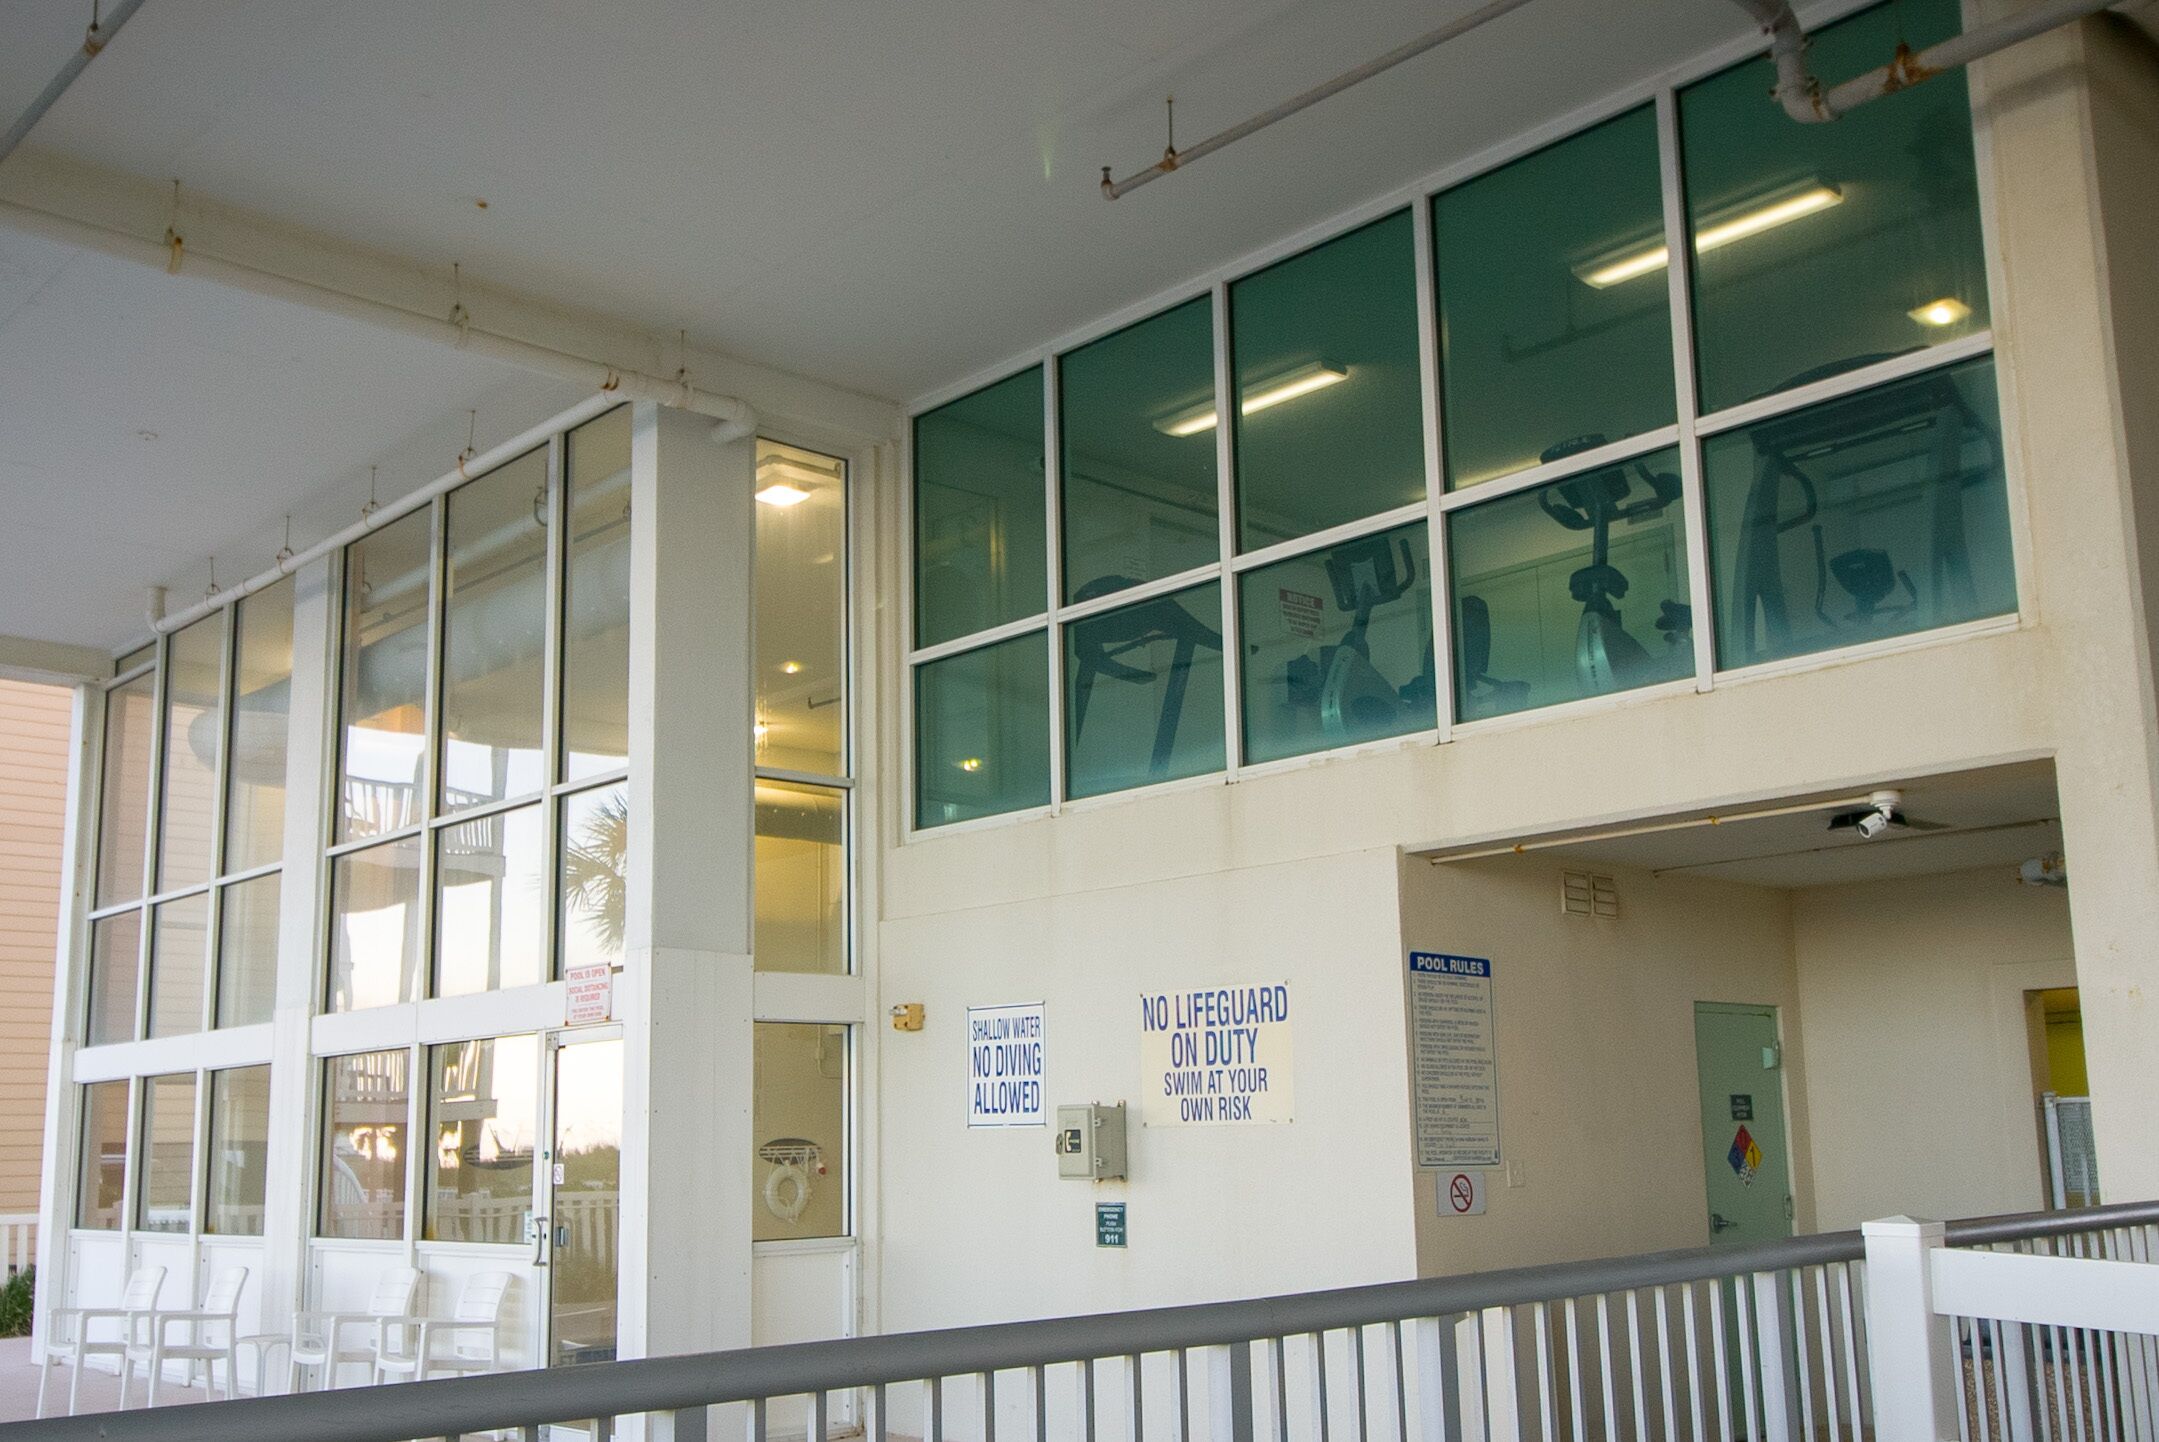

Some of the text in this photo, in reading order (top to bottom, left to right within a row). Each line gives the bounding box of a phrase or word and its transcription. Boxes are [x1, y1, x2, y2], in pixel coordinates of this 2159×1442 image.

[570, 967, 606, 981] POOL IS OPEN
[1417, 956, 1484, 975] POOL RULES
[1142, 985, 1288, 1032] NO LIFEGUARD
[972, 1016, 1041, 1041] SHALLOW WATER
[973, 1042, 1041, 1078] NO DIVING
[1171, 1027, 1258, 1068] ON DUTY
[1164, 1067, 1268, 1096] SWIM AT YOUR
[974, 1081, 1040, 1114] ALLOWED
[1180, 1095, 1252, 1122] OWN RISK
[1104, 1233, 1119, 1244] 911
